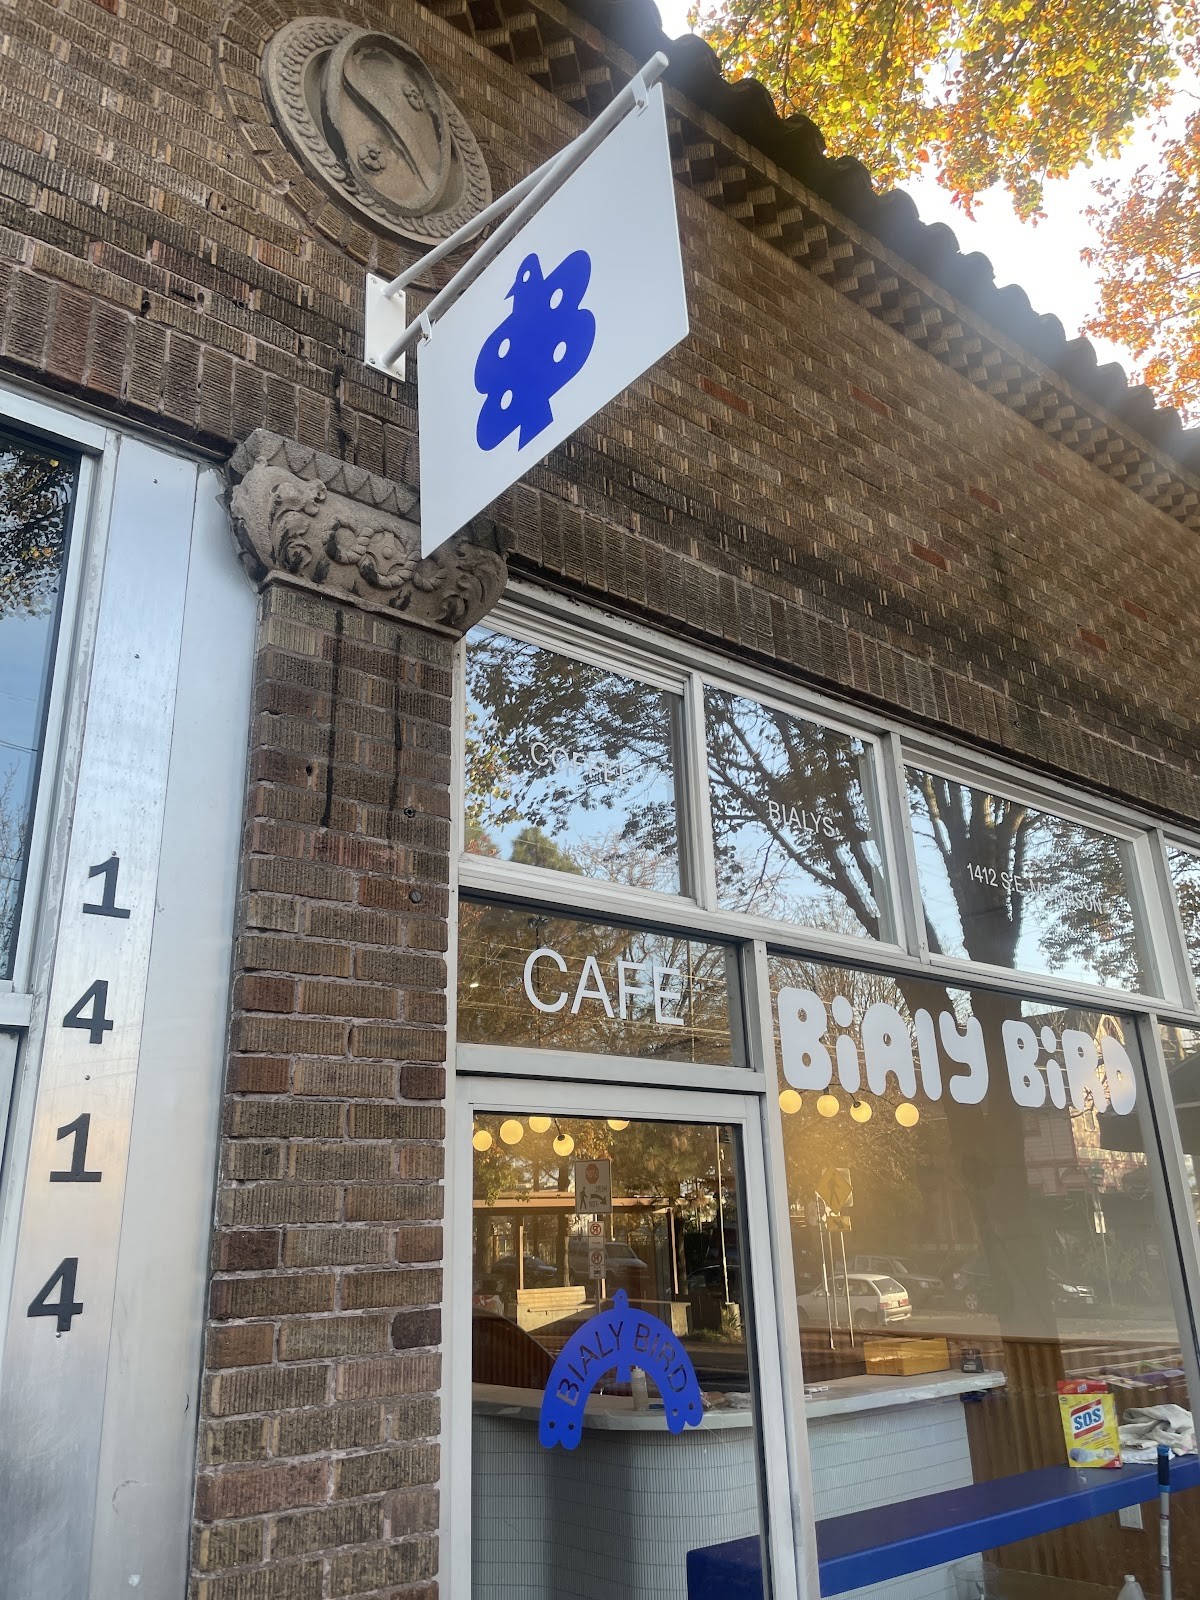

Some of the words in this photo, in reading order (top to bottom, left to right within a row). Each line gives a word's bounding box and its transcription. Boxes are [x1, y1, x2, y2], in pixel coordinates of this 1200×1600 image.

[768, 800, 836, 838] BIALYS
[966, 862, 999, 888] 1412
[523, 948, 684, 1026] CAFE
[556, 1321, 624, 1408] BIALY
[633, 1322, 689, 1393] BIRD
